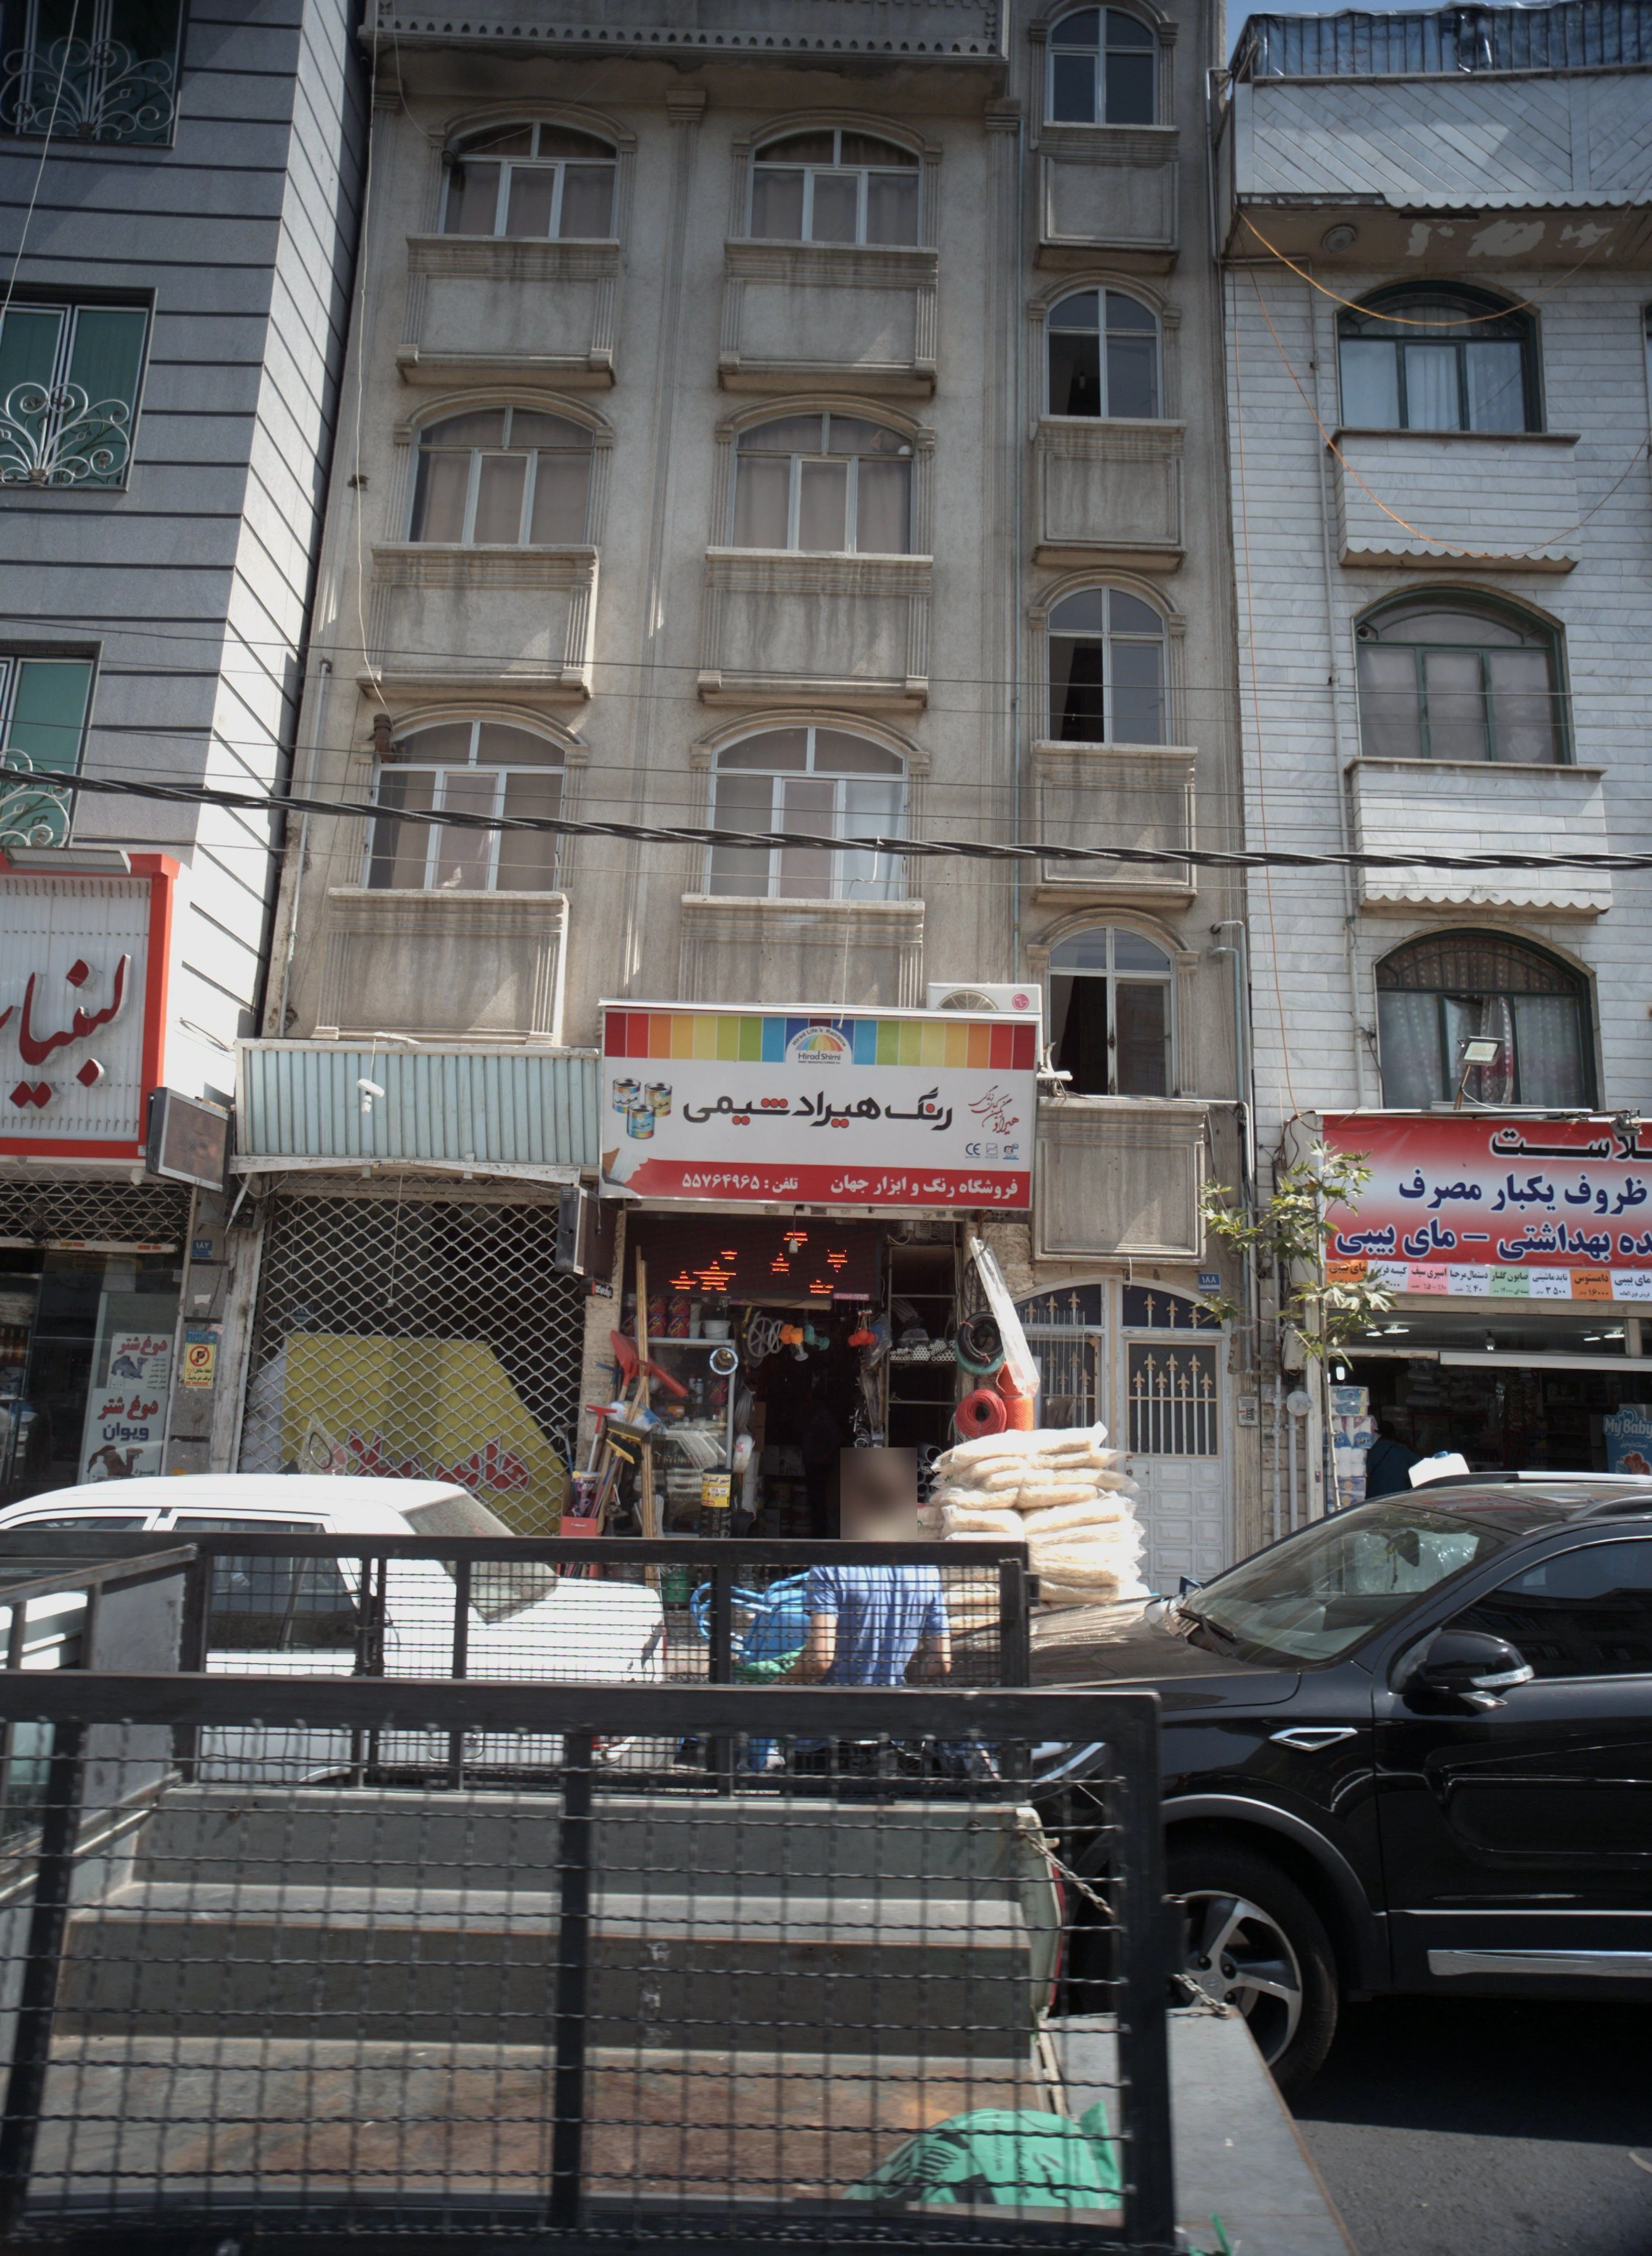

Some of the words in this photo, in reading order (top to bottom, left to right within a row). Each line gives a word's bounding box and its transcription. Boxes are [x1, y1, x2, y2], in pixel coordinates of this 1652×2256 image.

[0, 953, 131, 1108] لبنیا
[792, 1032, 806, 1046] Hirad
[826, 1028, 847, 1047] Rainbow
[798, 1050, 820, 1060] Hirad
[821, 1053, 841, 1061] Shimi
[683, 1096, 791, 1125] شیمی
[791, 1091, 881, 1128] هیراد
[885, 1086, 953, 1131] رنگ
[965, 1143, 981, 1156] CE
[681, 1173, 760, 1190] ۵۵۷۶۴۹۶۵
[771, 1176, 798, 1194] تلفن
[830, 1174, 869, 1194] جهان
[872, 1175, 907, 1196] ابزار
[910, 1182, 920, 1196] و
[922, 1177, 955, 1198] رنگ
[958, 1178, 1019, 1199] فروشگاه
[1399, 1168, 1482, 1209] مصرف
[1490, 1173, 1557, 1211] یکبار
[1564, 1174, 1648, 1215] ظروف
[1336, 1225, 1395, 1255] بیبی
[1404, 1218, 1456, 1256] مای
[1498, 1223, 1611, 1261] بهداشتی
[1201, 1275, 1217, 1284] ۱۸۸
[1507, 1272, 1529, 1283] صابون
[1634, 1274, 1652, 1287] مای
[117, 1336, 140, 1355] شتر
[140, 1335, 168, 1356] دوغ
[97, 1396, 124, 1420] شتر
[127, 1395, 158, 1420] دوغ
[1604, 1417, 1621, 1437] My
